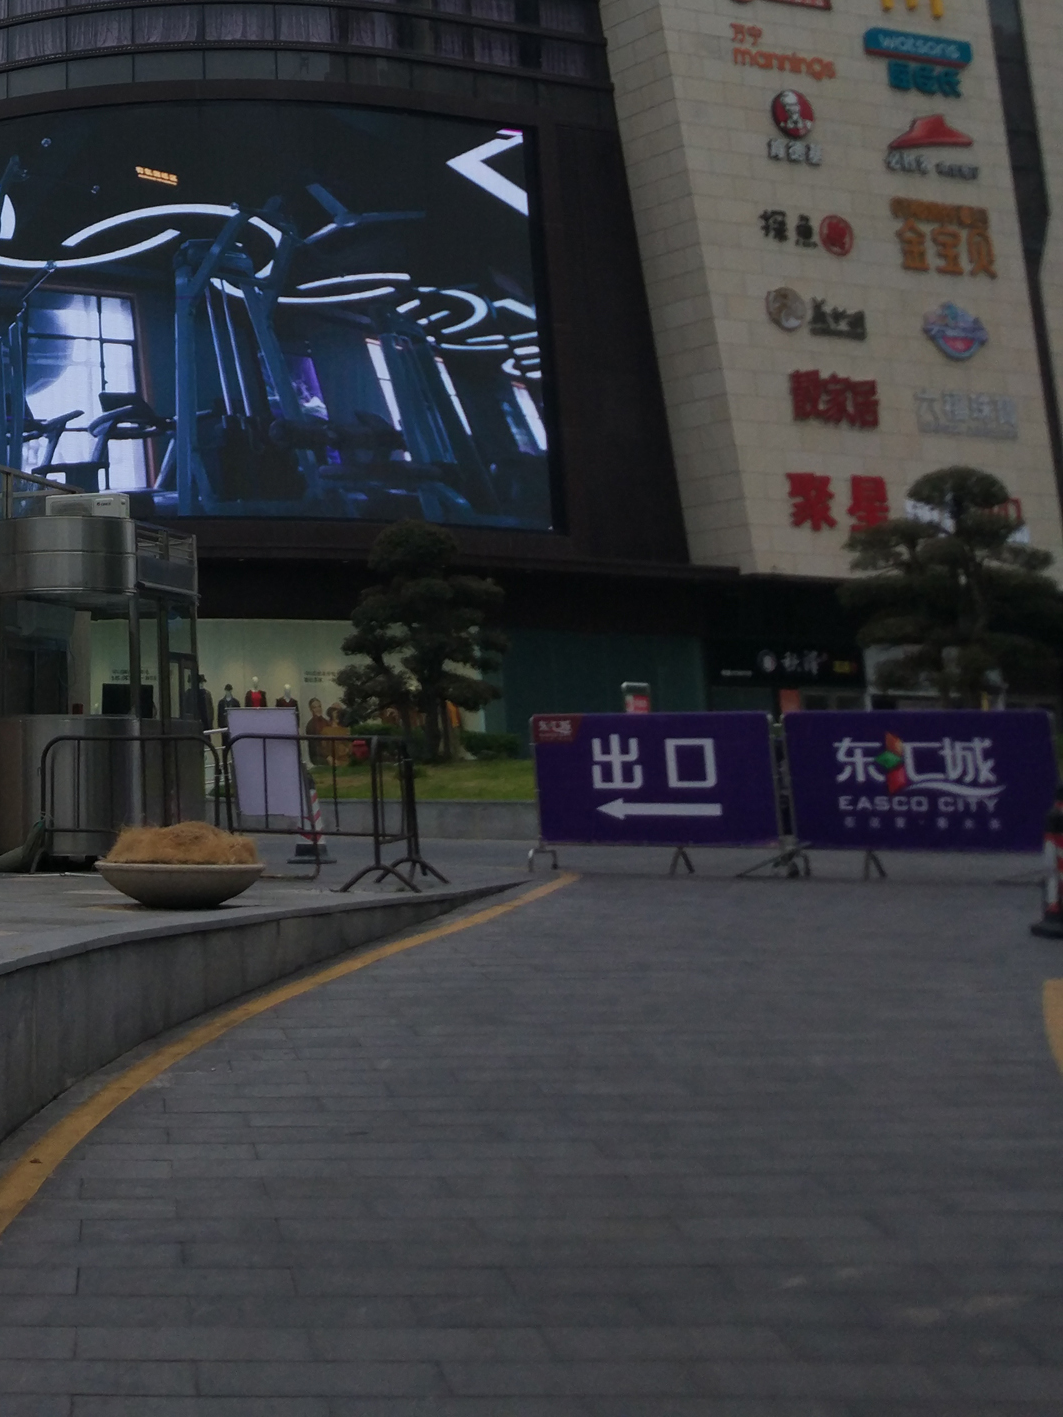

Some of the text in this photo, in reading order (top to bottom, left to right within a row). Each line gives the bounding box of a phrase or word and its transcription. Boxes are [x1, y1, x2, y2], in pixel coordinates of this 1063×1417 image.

[733, 47, 836, 80] mannings
[878, 33, 961, 60] watsons
[896, 218, 998, 279] 金宝贝
[786, 473, 889, 531] 聚星
[591, 733, 717, 790] 出口
[833, 736, 996, 785] 东汇城
[838, 795, 999, 814] EASCO CITY
